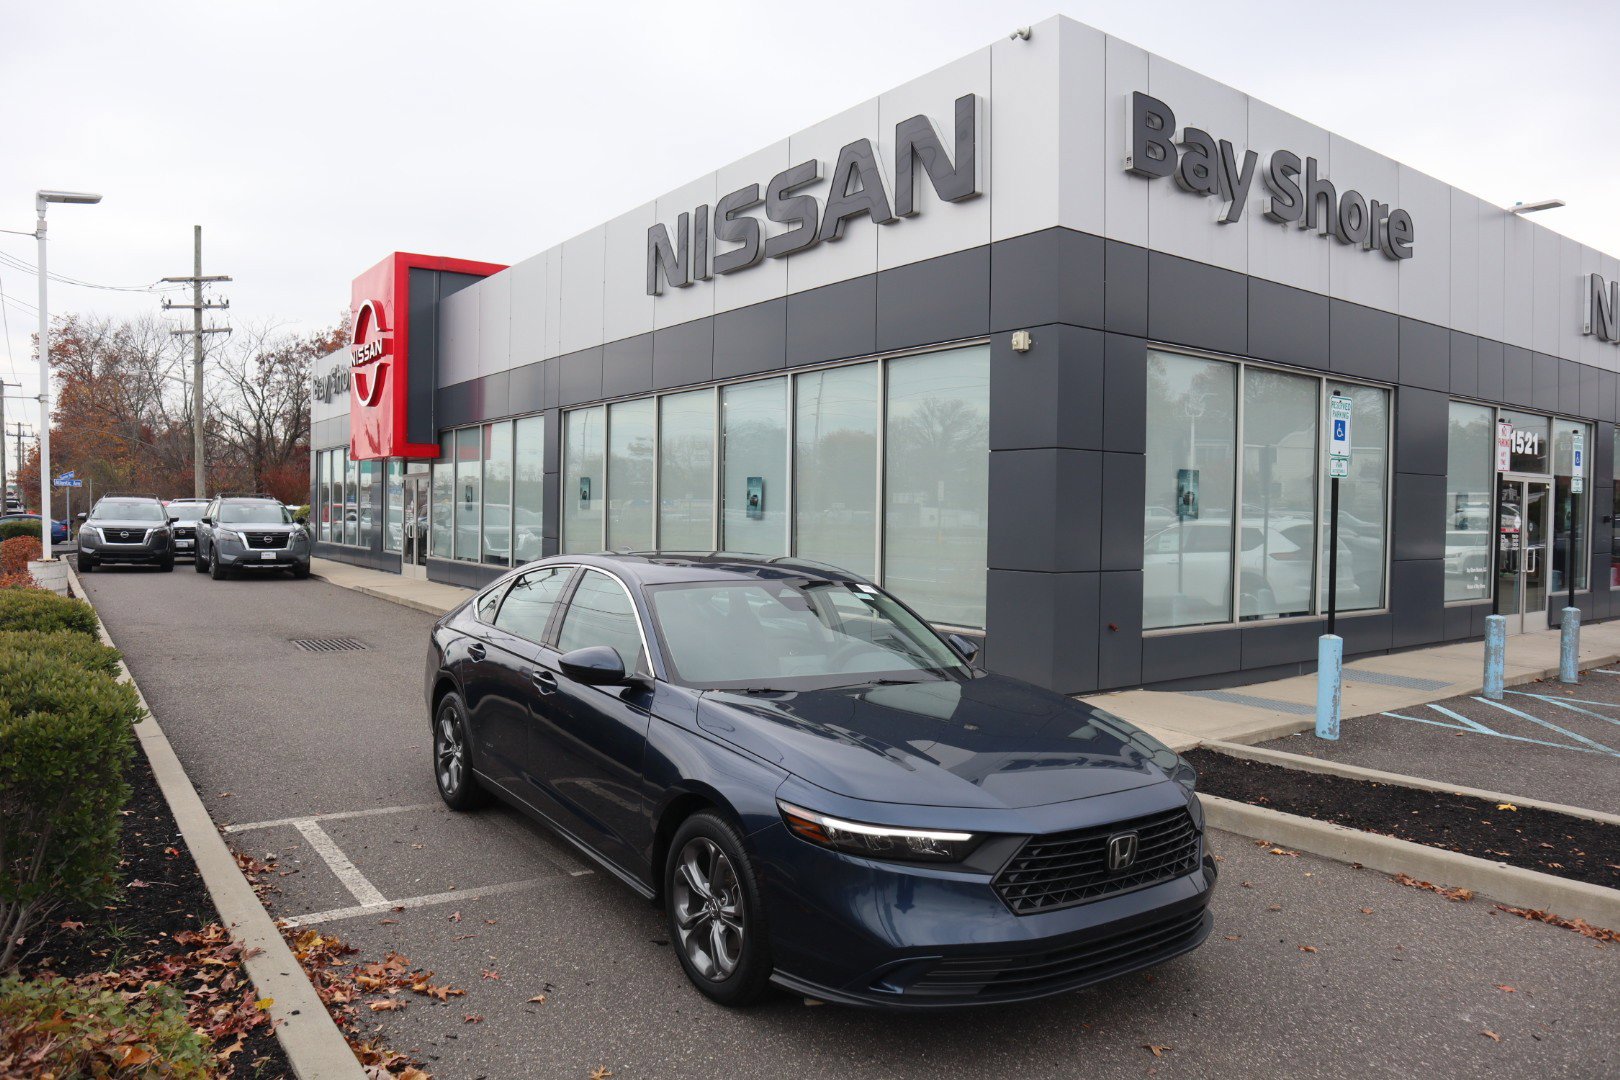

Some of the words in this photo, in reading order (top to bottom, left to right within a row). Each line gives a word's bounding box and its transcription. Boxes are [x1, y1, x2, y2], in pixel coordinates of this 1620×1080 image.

[1125, 91, 1258, 224] Bay
[1263, 149, 1414, 260] Shore
[647, 93, 982, 296] NISSAN
[351, 339, 382, 367] NISSAN
[312, 374, 331, 404] Bay
[1331, 400, 1351, 411] RESERVED
[1332, 410, 1350, 420] PARKING
[1511, 430, 1539, 455] 1521
